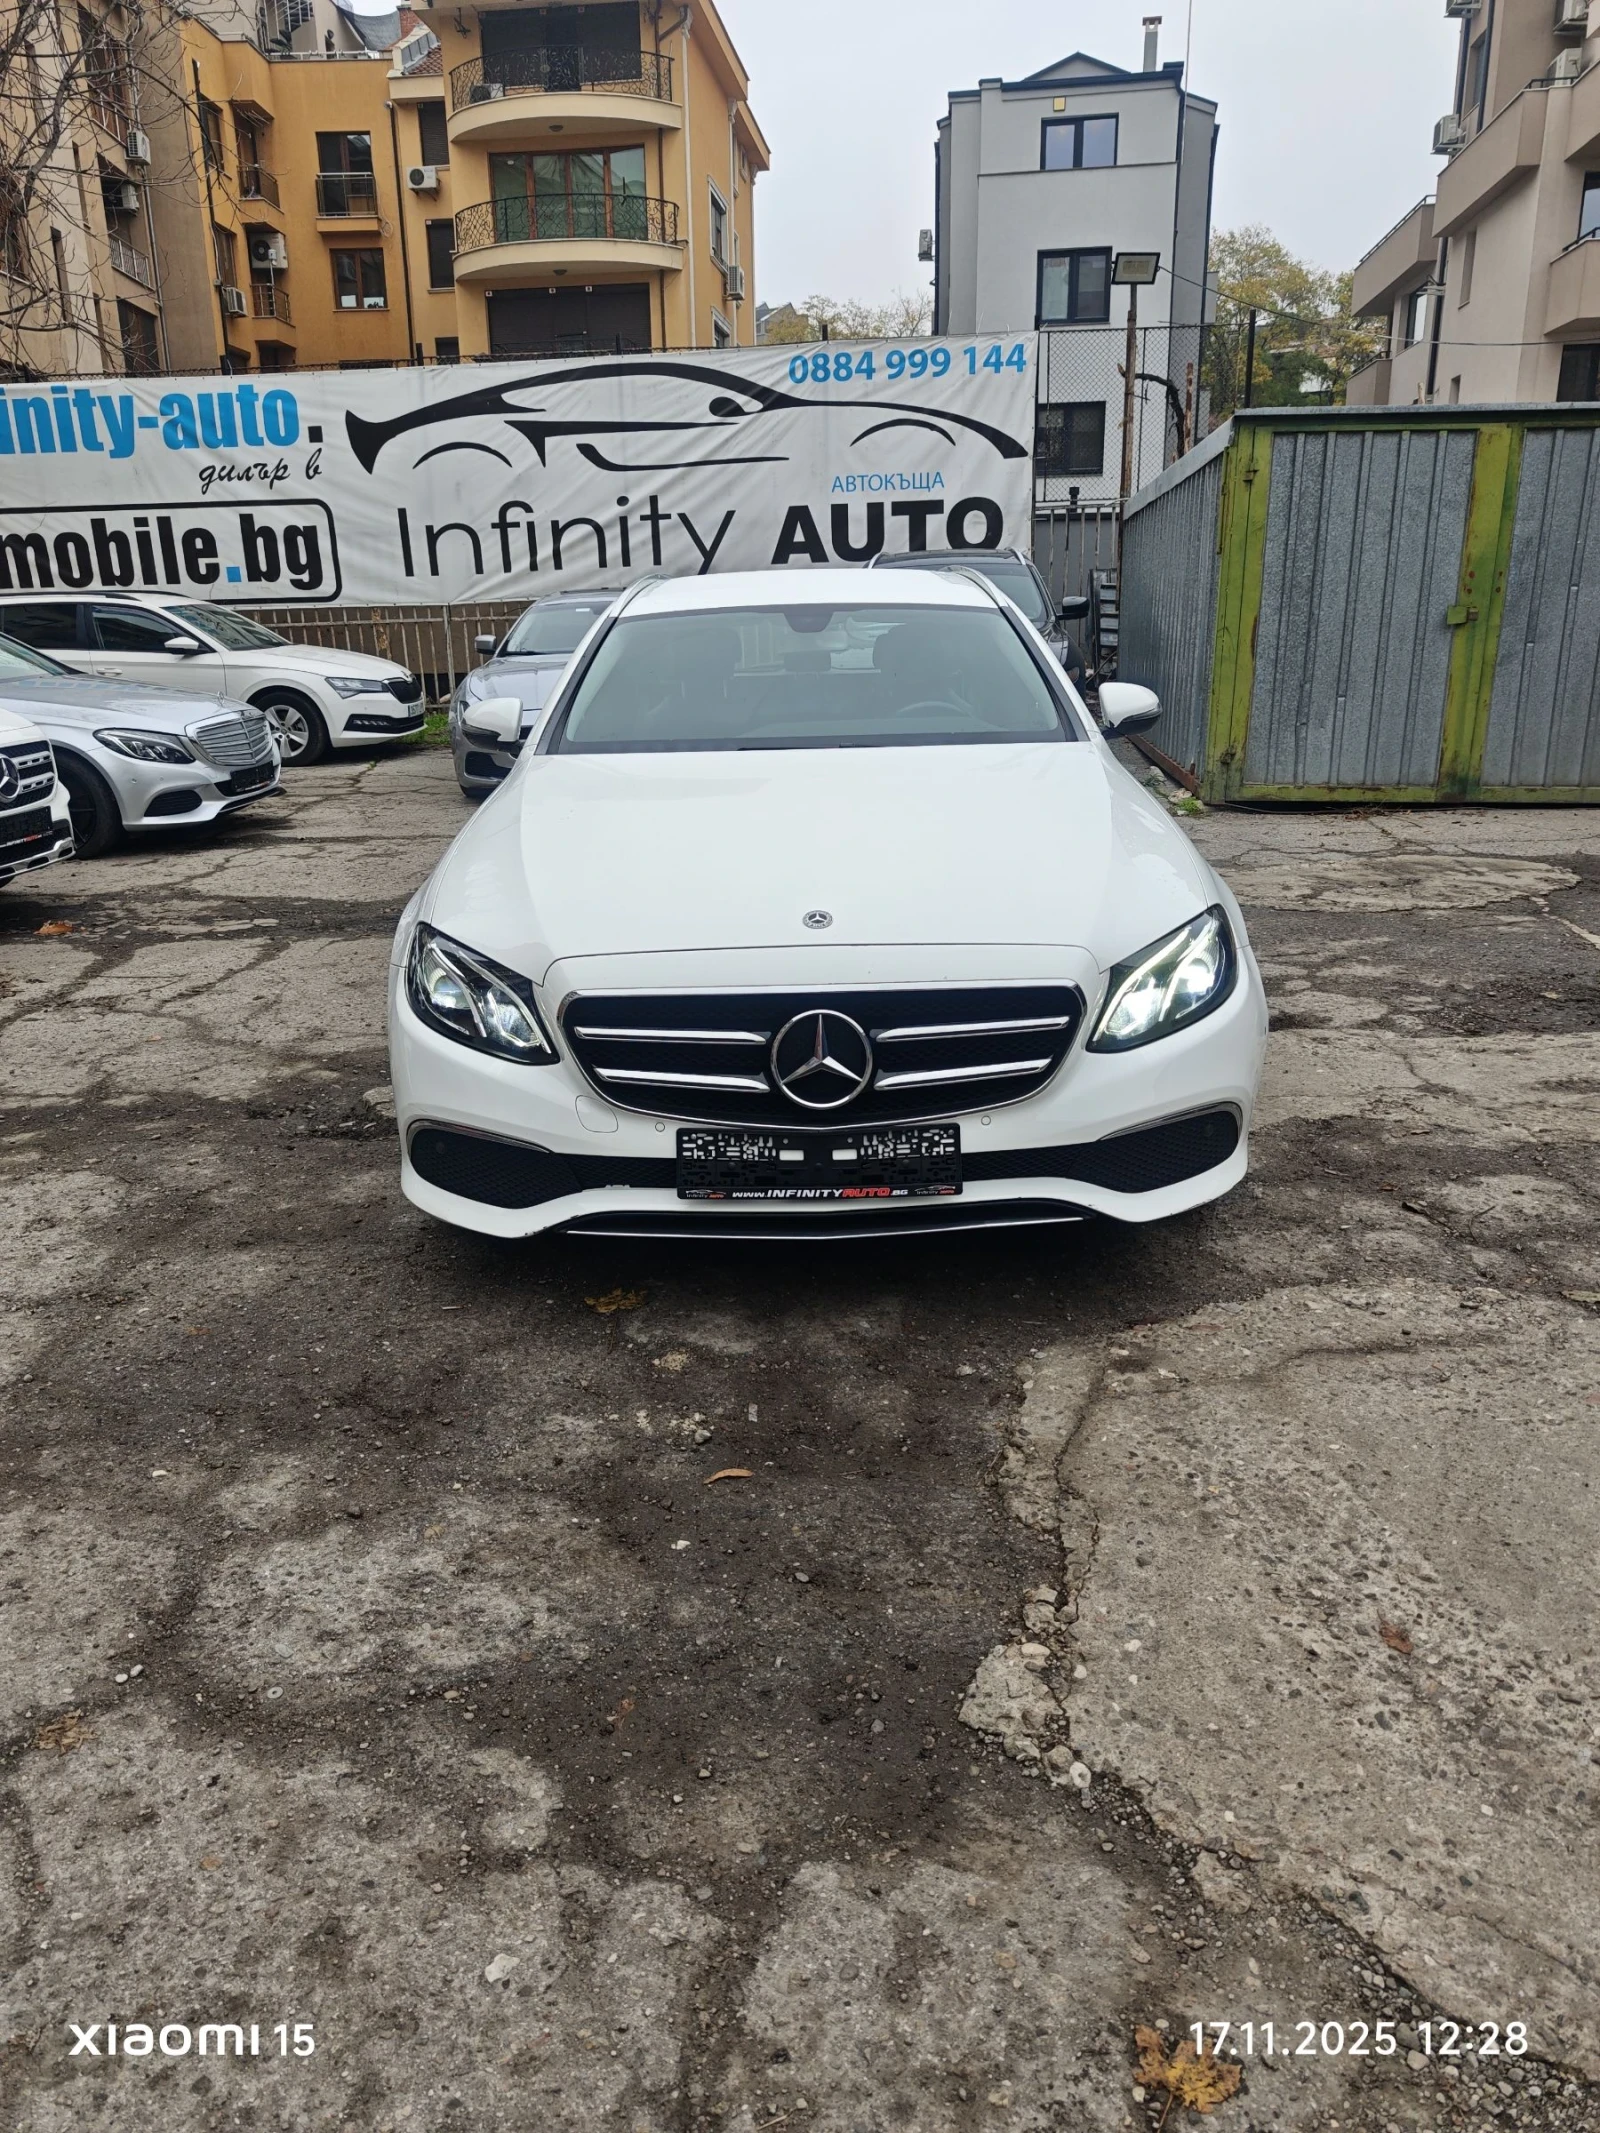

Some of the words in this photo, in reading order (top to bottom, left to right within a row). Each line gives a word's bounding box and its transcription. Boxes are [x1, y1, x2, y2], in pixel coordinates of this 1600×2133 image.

[788, 351, 876, 384] 0884
[885, 347, 951, 380] 999
[963, 343, 1027, 375] 144
[199, 458, 290, 495] дилър
[305, 447, 322, 480] в
[831, 471, 945, 493] АВТОКЪЩА
[0, 513, 323, 591] mobile.bg
[397, 494, 737, 577] Infinity
[771, 497, 1004, 564] AUTO
